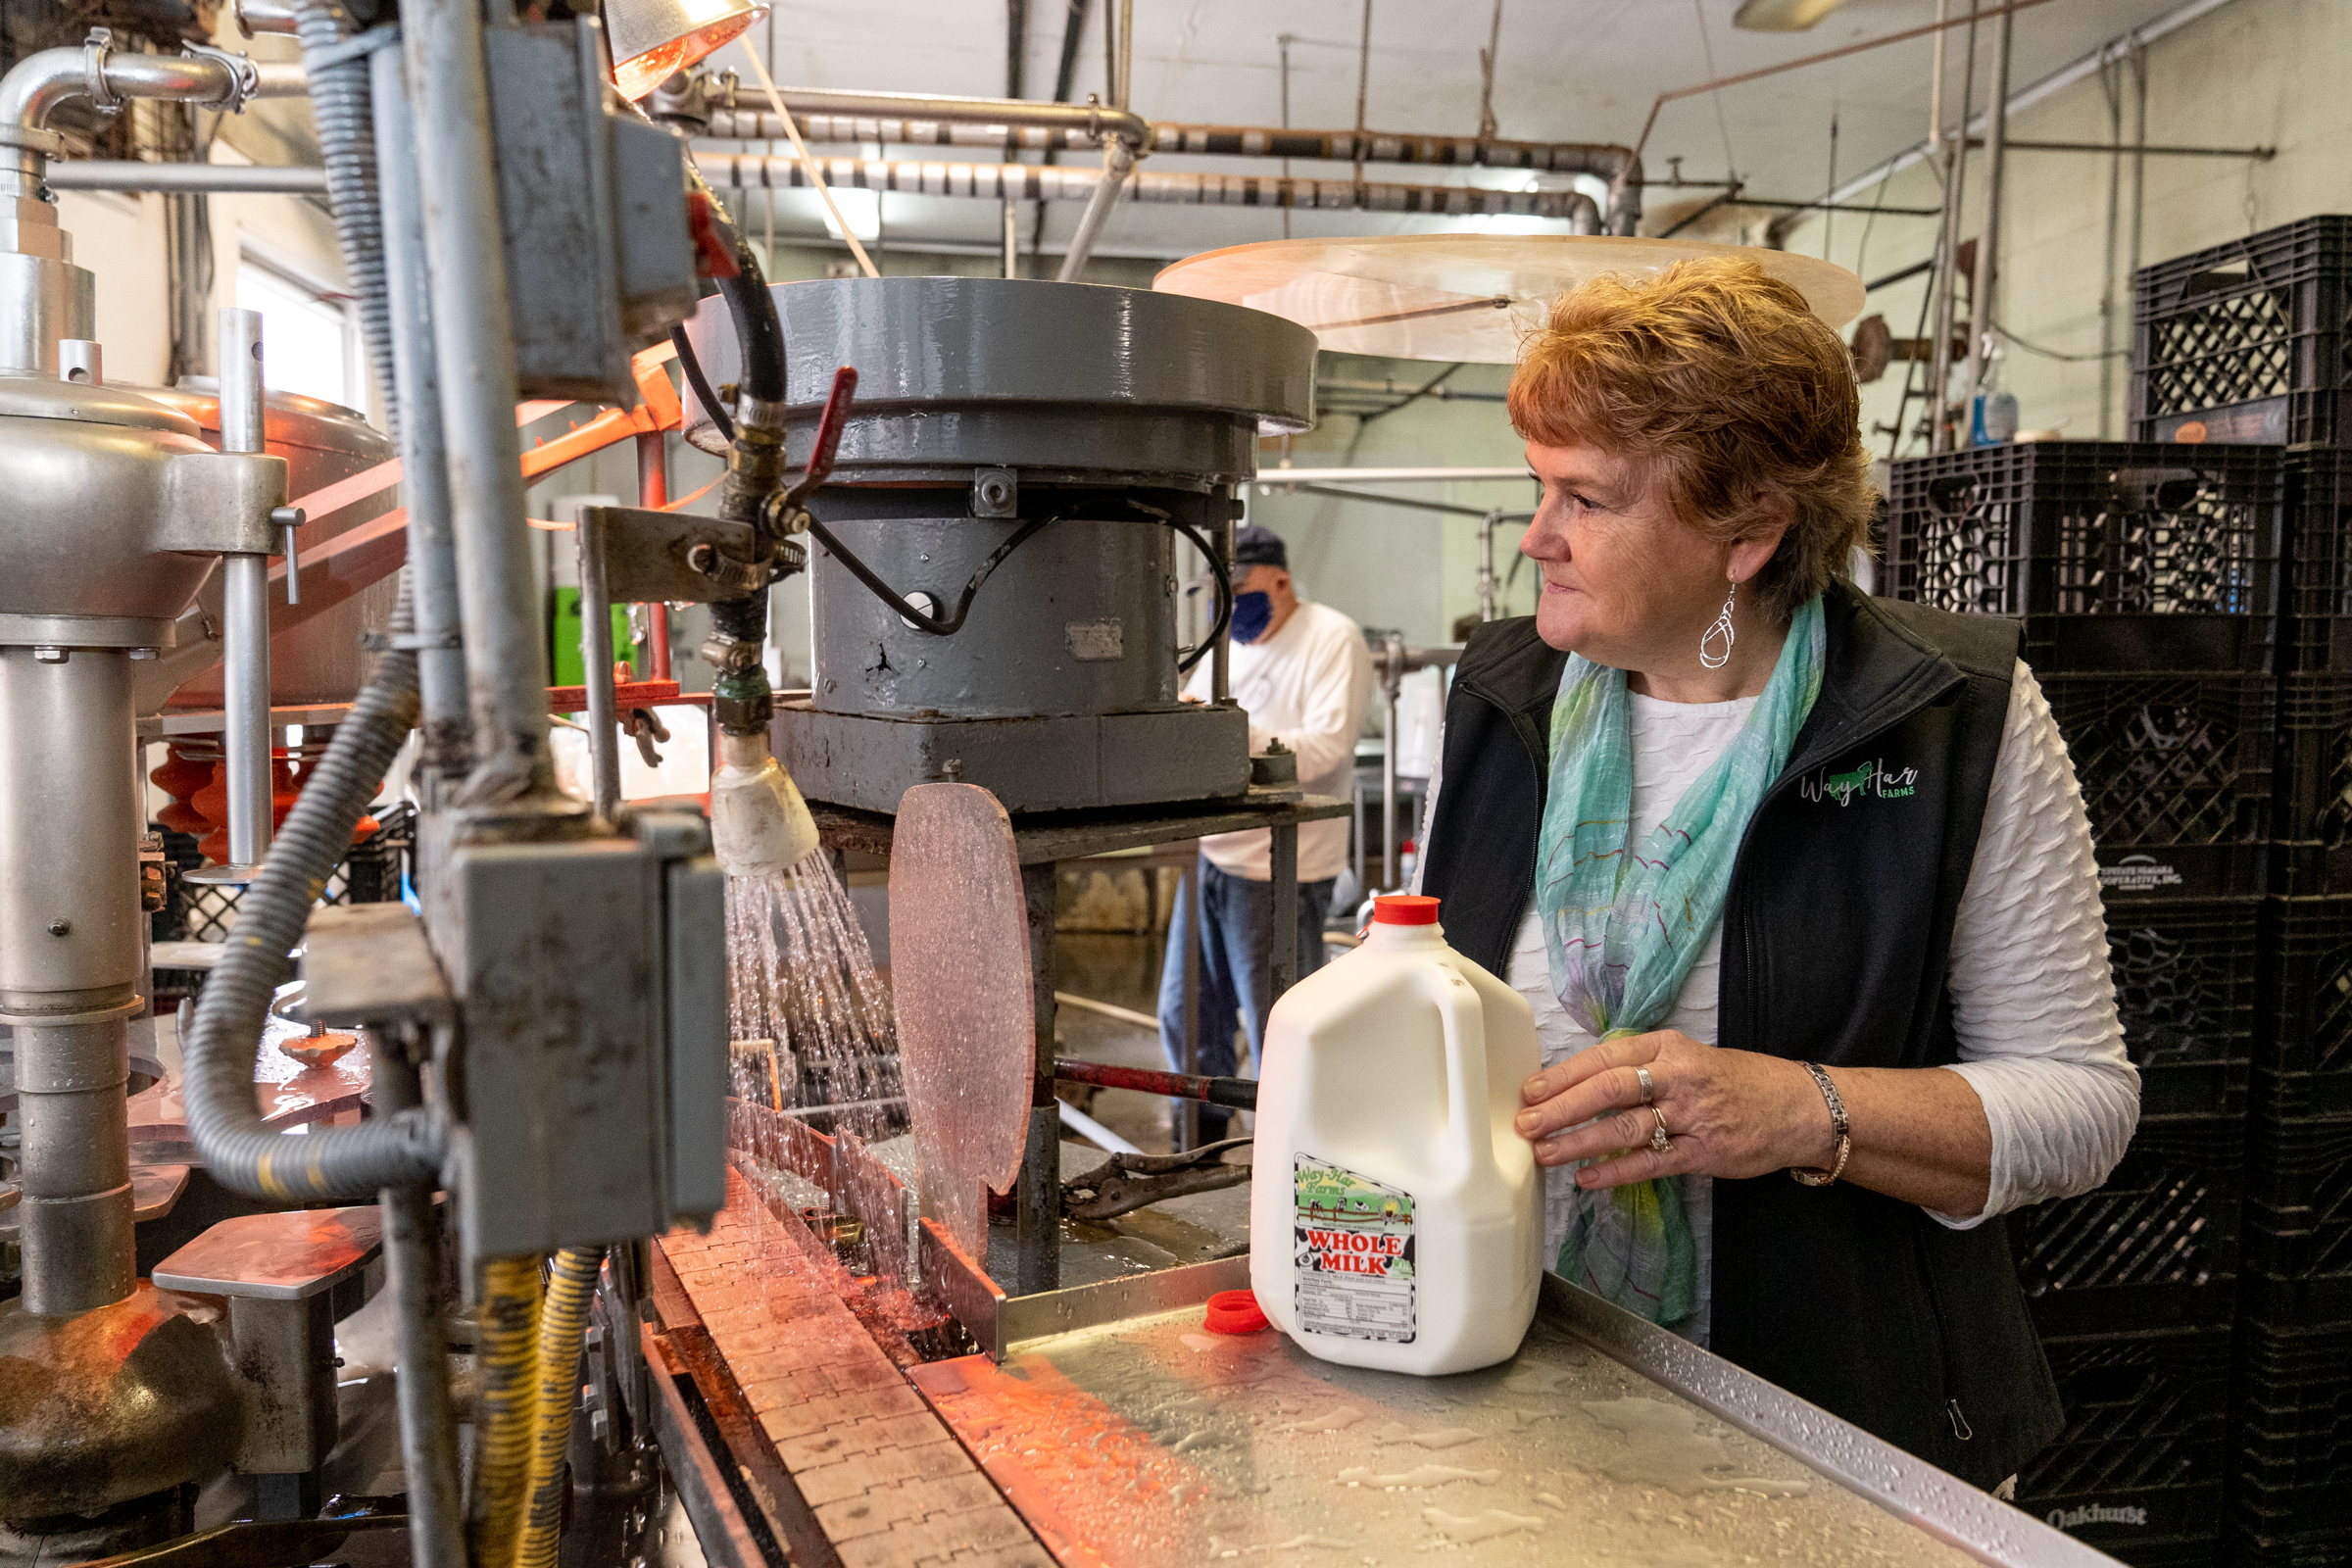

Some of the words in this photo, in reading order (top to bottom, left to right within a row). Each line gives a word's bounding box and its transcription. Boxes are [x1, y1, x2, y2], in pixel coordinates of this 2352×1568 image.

[1800, 766, 1860, 807] Way
[1883, 786, 1915, 799] FARMS
[2098, 874, 2162, 885] OOPERATIVE,
[1306, 1181, 1347, 1196] Farms
[1307, 1230, 1401, 1255] WHOLE
[1321, 1252, 1387, 1275] MILK
[2046, 1502, 2147, 1531] Oakhurst
